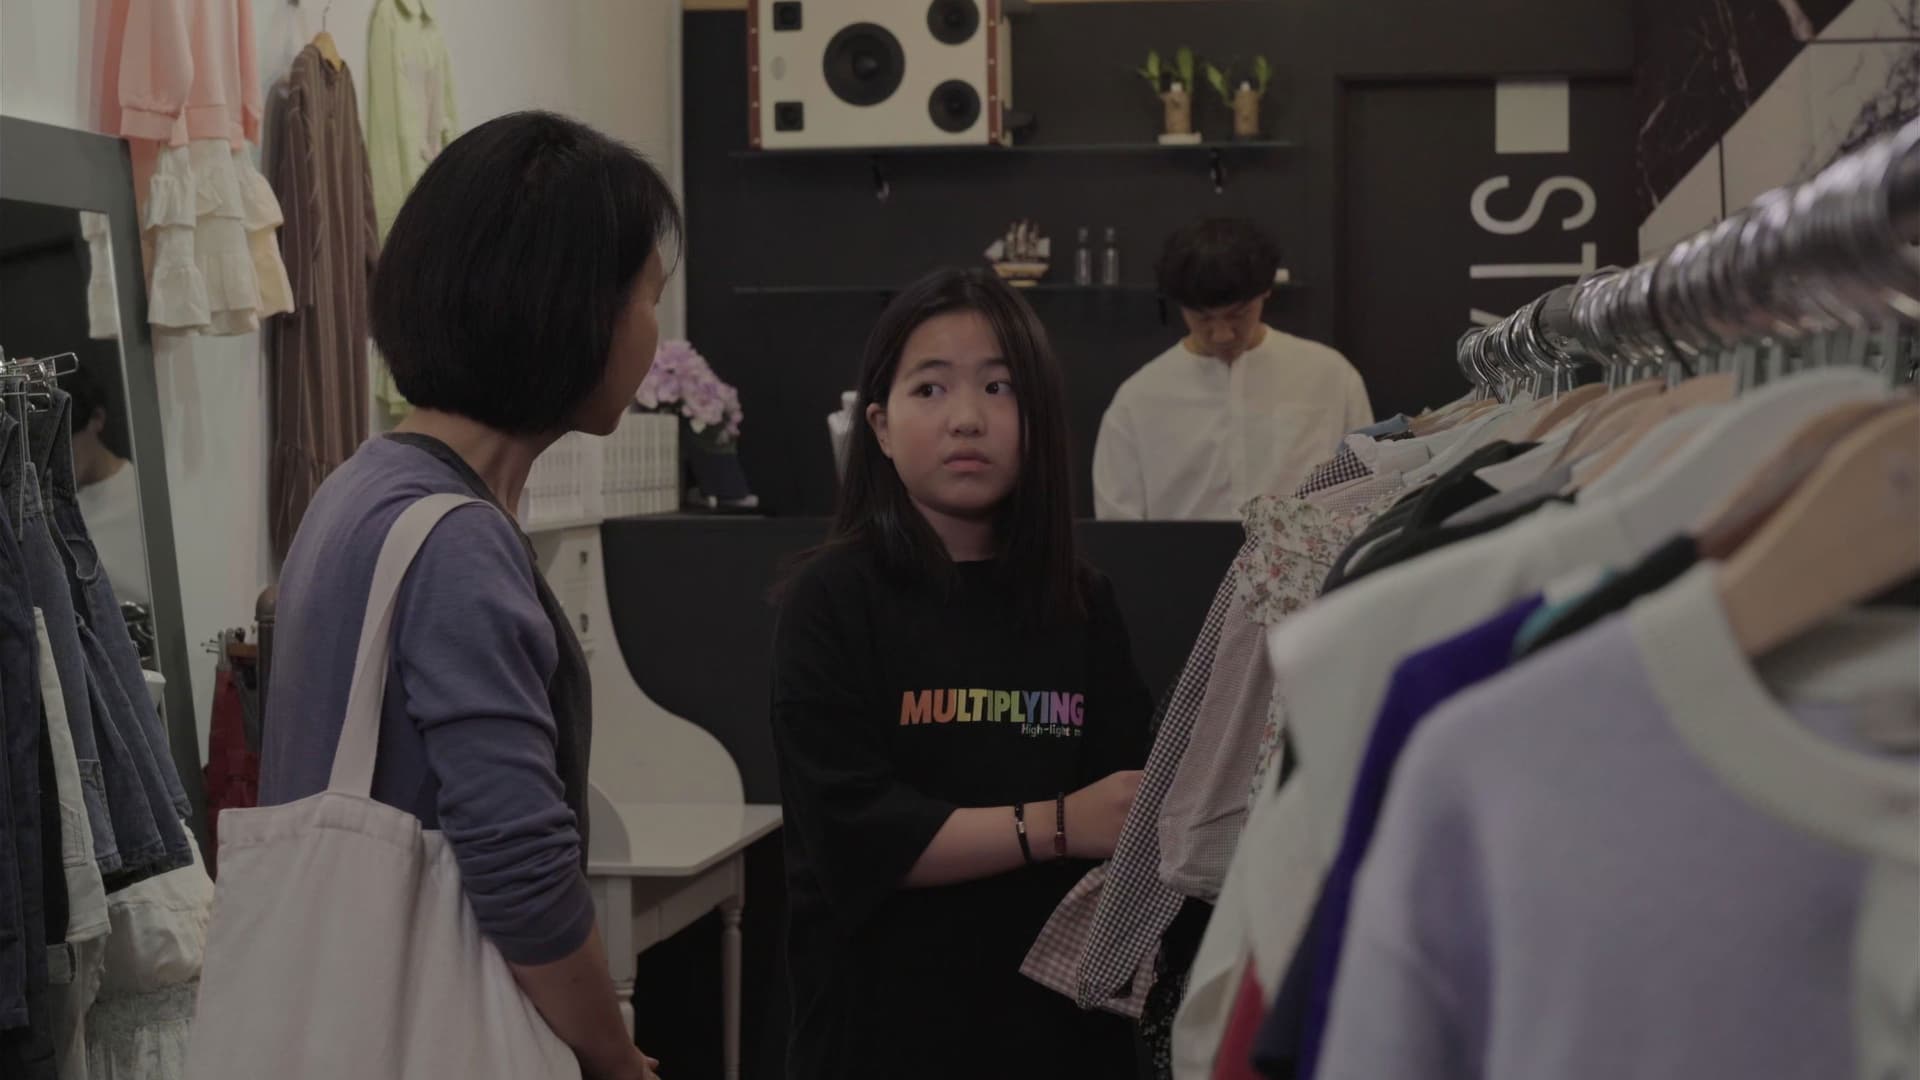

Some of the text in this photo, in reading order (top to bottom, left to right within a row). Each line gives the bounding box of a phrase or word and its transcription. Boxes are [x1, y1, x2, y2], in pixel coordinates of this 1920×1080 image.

[1470, 175, 1597, 328] ST
[899, 688, 1085, 727] MULTIPLYING
[1021, 723, 1072, 738] High-light
